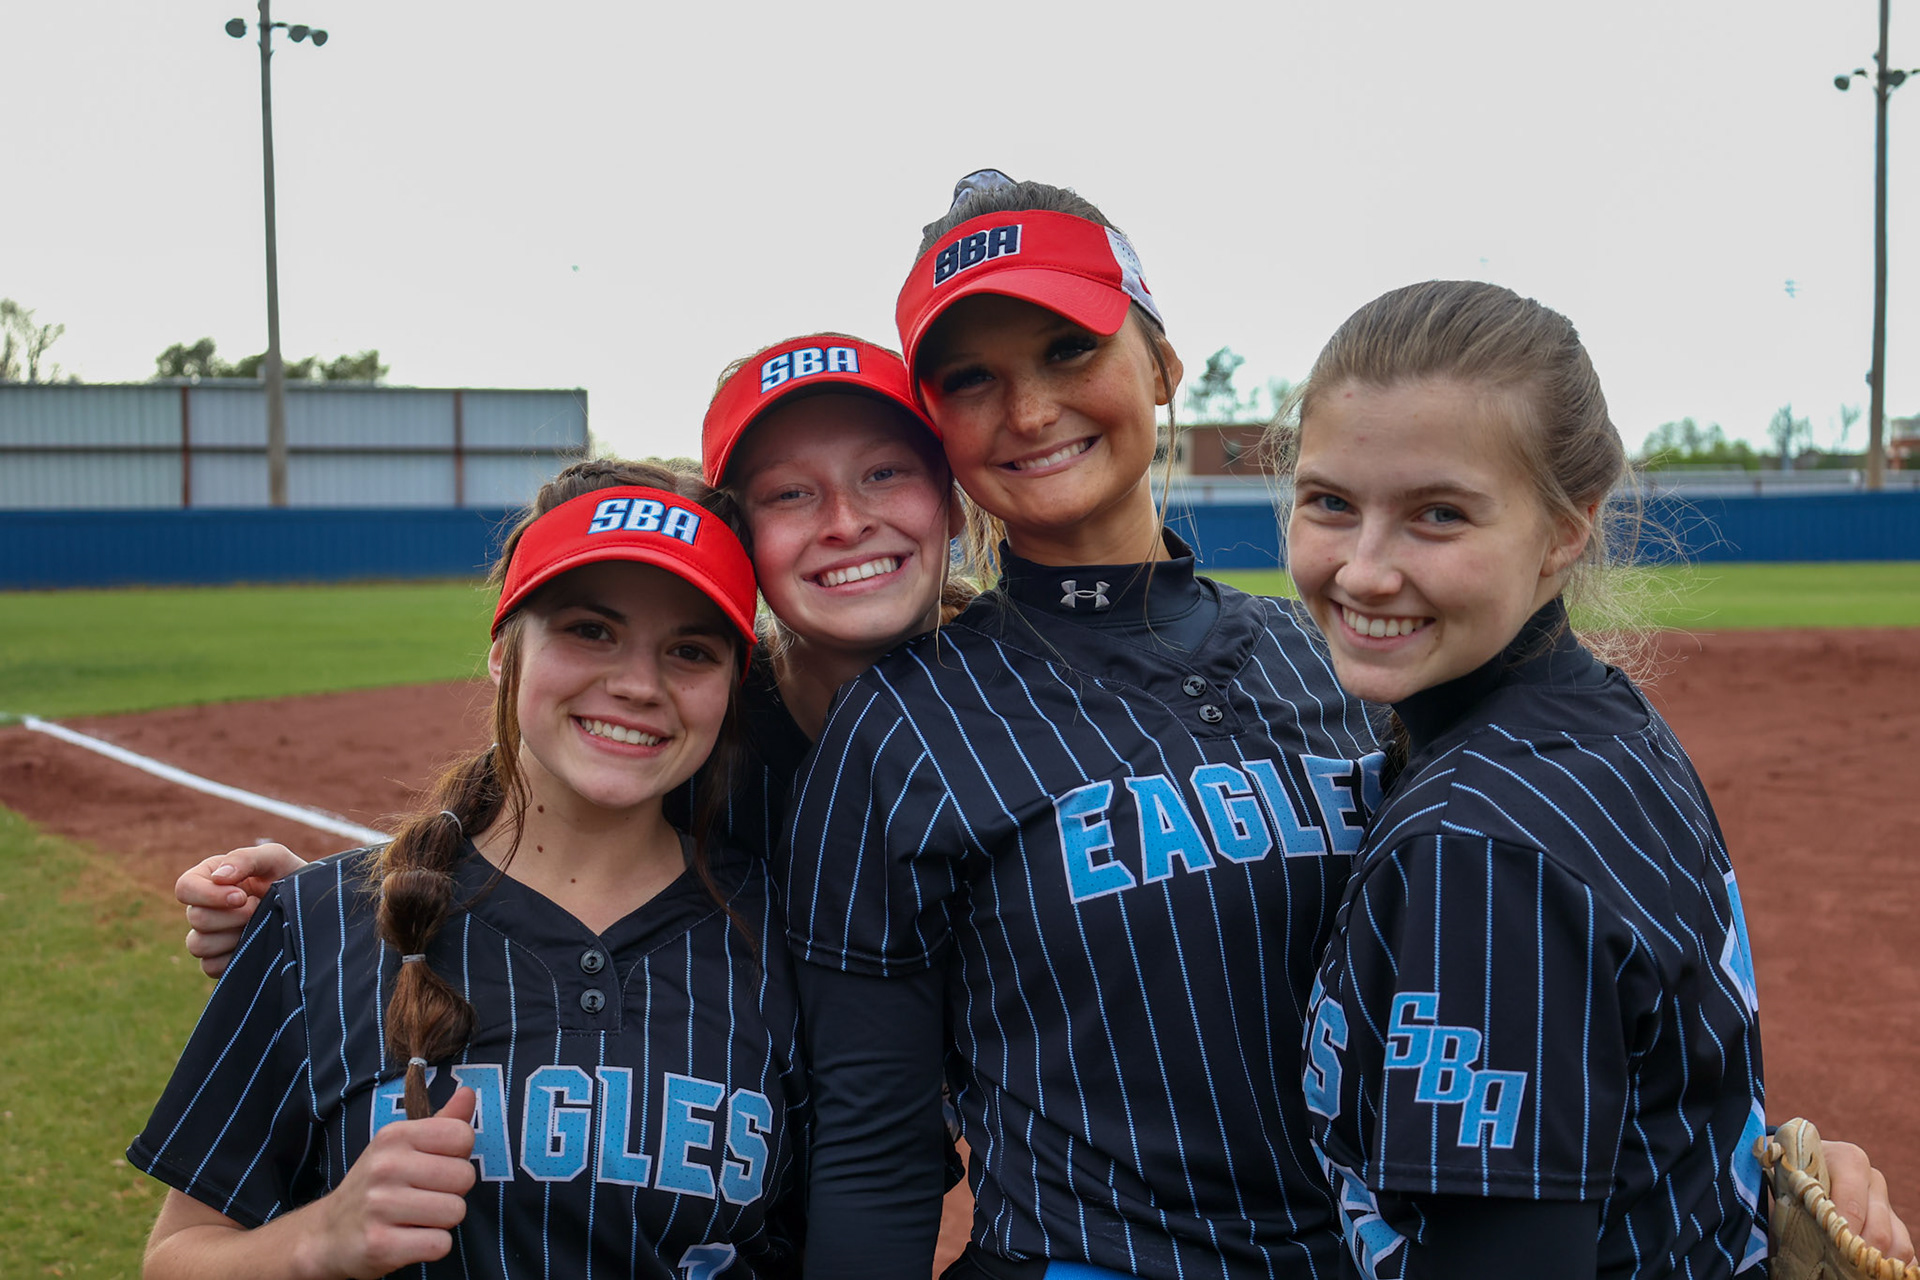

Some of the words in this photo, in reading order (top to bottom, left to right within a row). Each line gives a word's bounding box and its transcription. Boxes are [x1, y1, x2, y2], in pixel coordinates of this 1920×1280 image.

[933, 224, 1022, 288] SBA
[760, 346, 860, 393] SBA
[587, 498, 701, 546] SBA
[1052, 751, 1386, 904] EAGLE
[1383, 992, 1528, 1149] SBA
